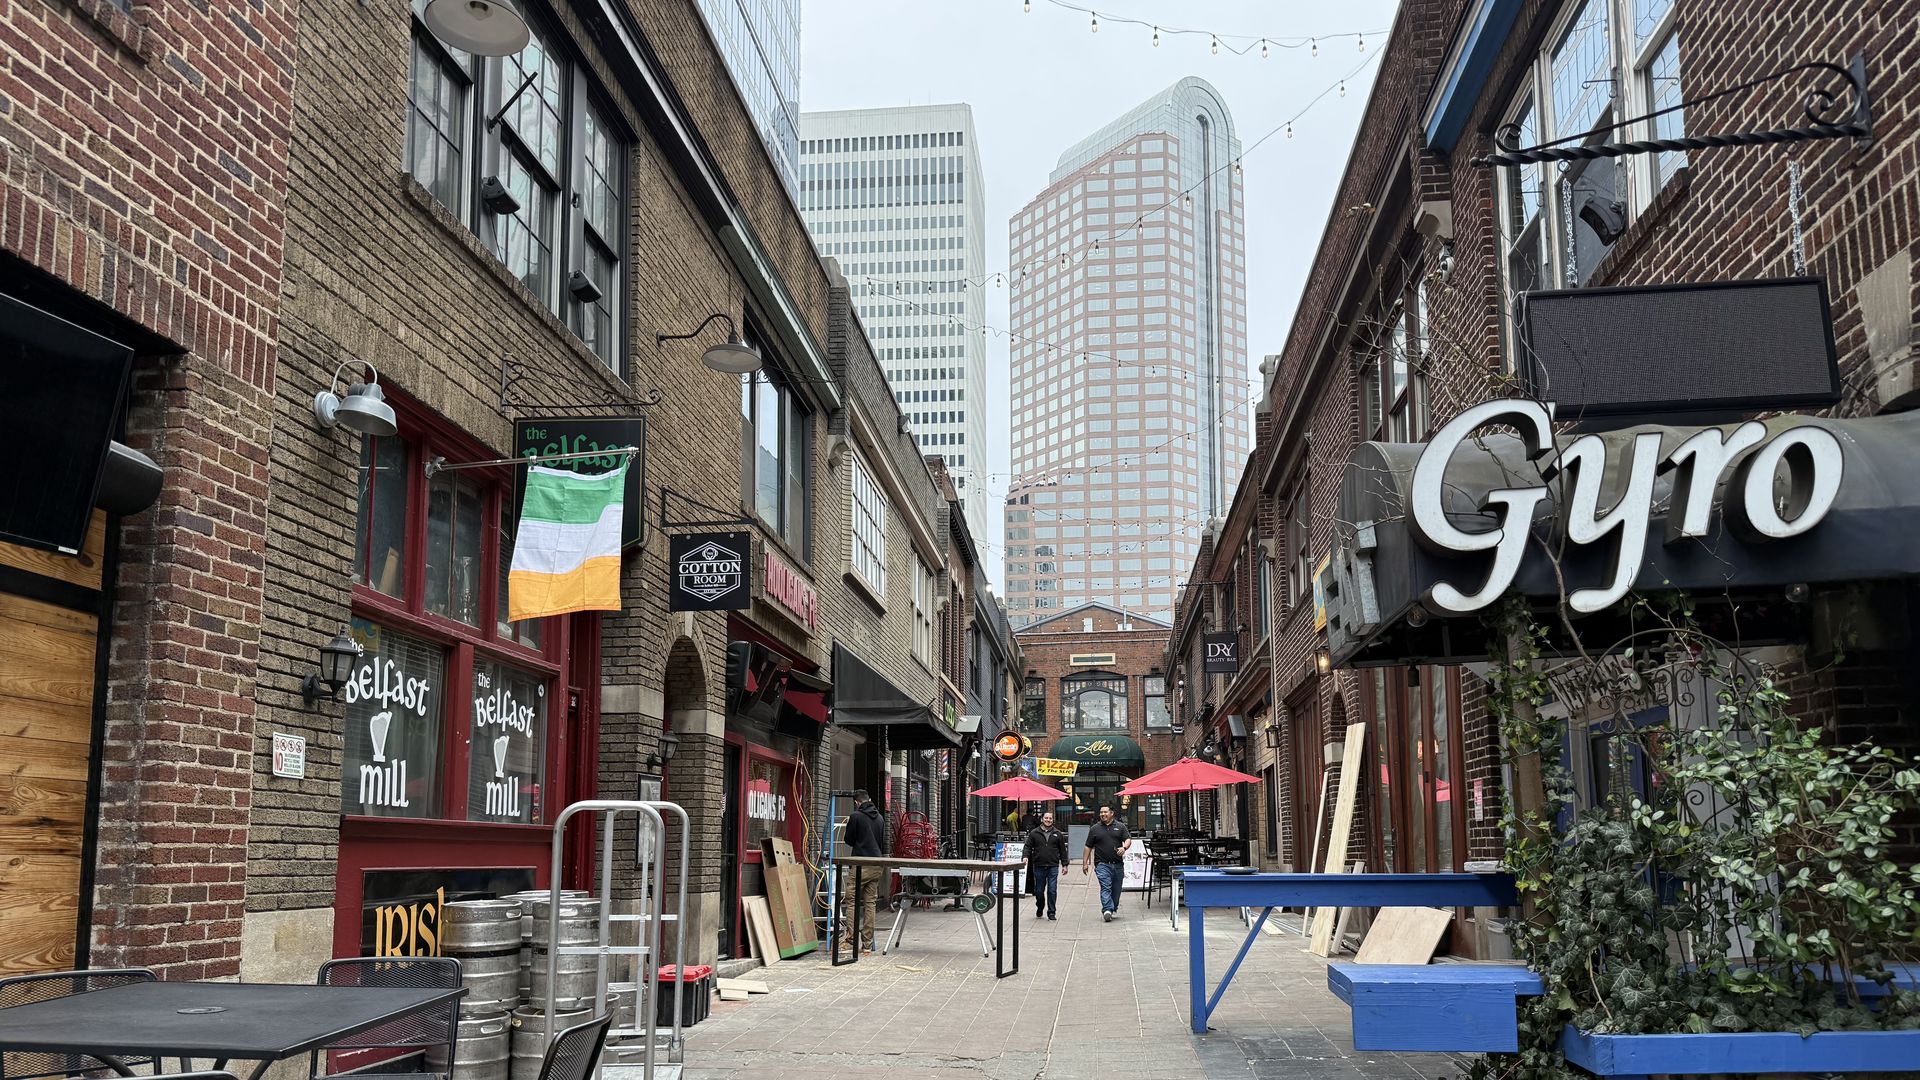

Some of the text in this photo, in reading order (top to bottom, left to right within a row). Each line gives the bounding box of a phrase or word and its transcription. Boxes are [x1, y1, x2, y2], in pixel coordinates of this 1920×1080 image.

[525, 427, 548, 440] the
[1410, 399, 1845, 614] Gyro
[679, 561, 741, 574] COTTON
[693, 575, 727, 584] ROOM
[1207, 642, 1235, 657] DRY
[345, 656, 430, 717] Belfast
[477, 672, 491, 688] the
[474, 688, 536, 738] Belfast
[1074, 739, 1113, 756] Alley
[274, 751, 284, 771] NO
[1038, 759, 1075, 770] PIZZA
[359, 758, 409, 808] mill
[486, 776, 521, 817] mill
[778, 794, 786, 822] FC
